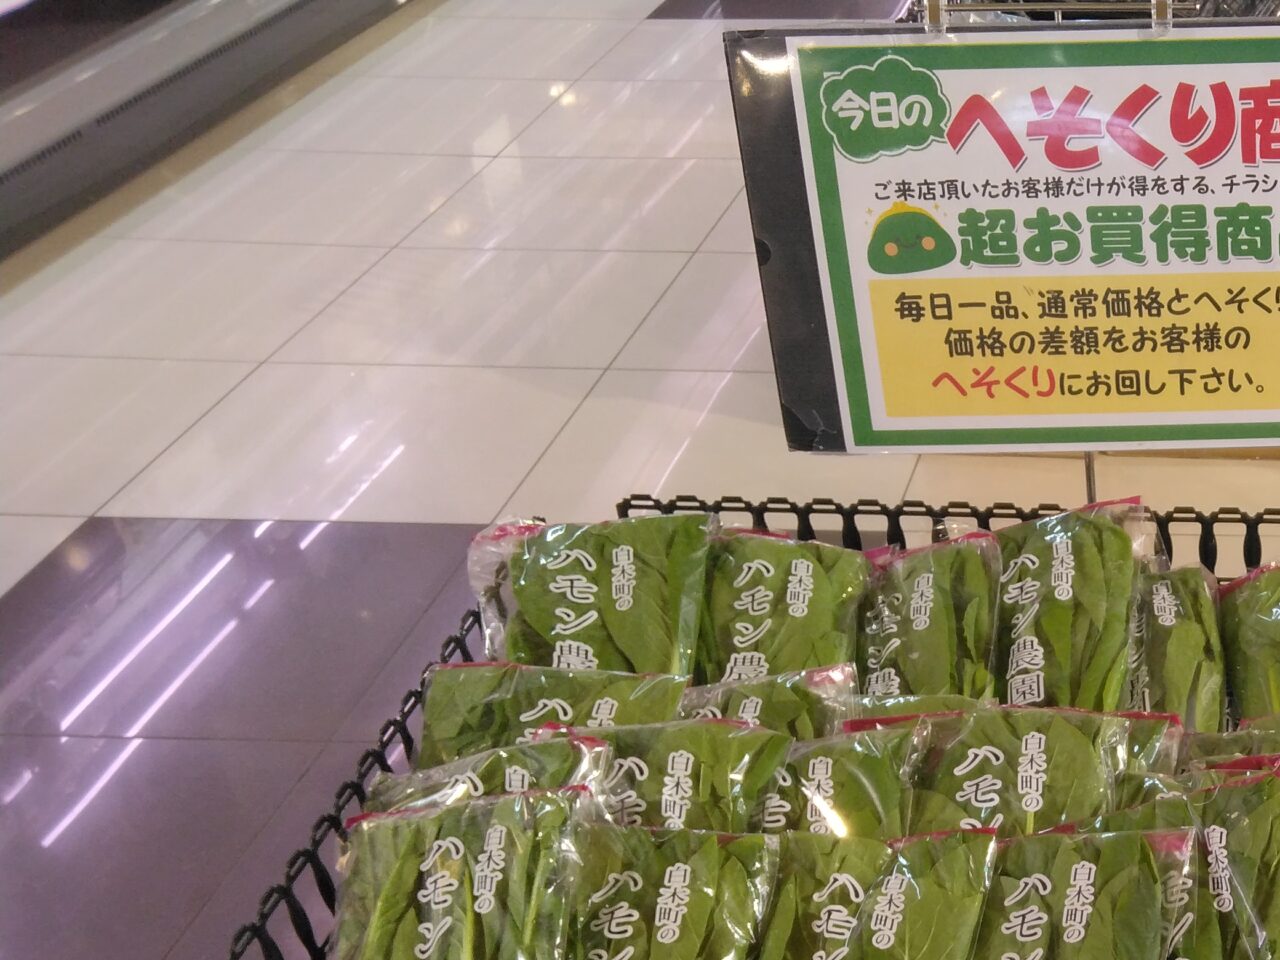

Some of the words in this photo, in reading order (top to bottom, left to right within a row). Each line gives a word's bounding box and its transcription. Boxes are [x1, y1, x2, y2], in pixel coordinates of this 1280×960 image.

[831, 93, 933, 129] 今日の
[944, 327, 1251, 358] 価格の差額をお客様の
[611, 545, 634, 611] 白木町の
[786, 559, 815, 617] 白木町の
[910, 573, 933, 631] 白木町の
[1051, 539, 1075, 600] 白木町の
[1001, 553, 1045, 705] ハモン農園
[1017, 731, 1047, 812] 白木町の
[474, 824, 506, 914] 白木町の
[655, 862, 691, 944] 白木町の
[1063, 861, 1096, 943] 白木町の
[1203, 824, 1234, 913] 白木町の
[870, 872, 906, 949] 白木町の
